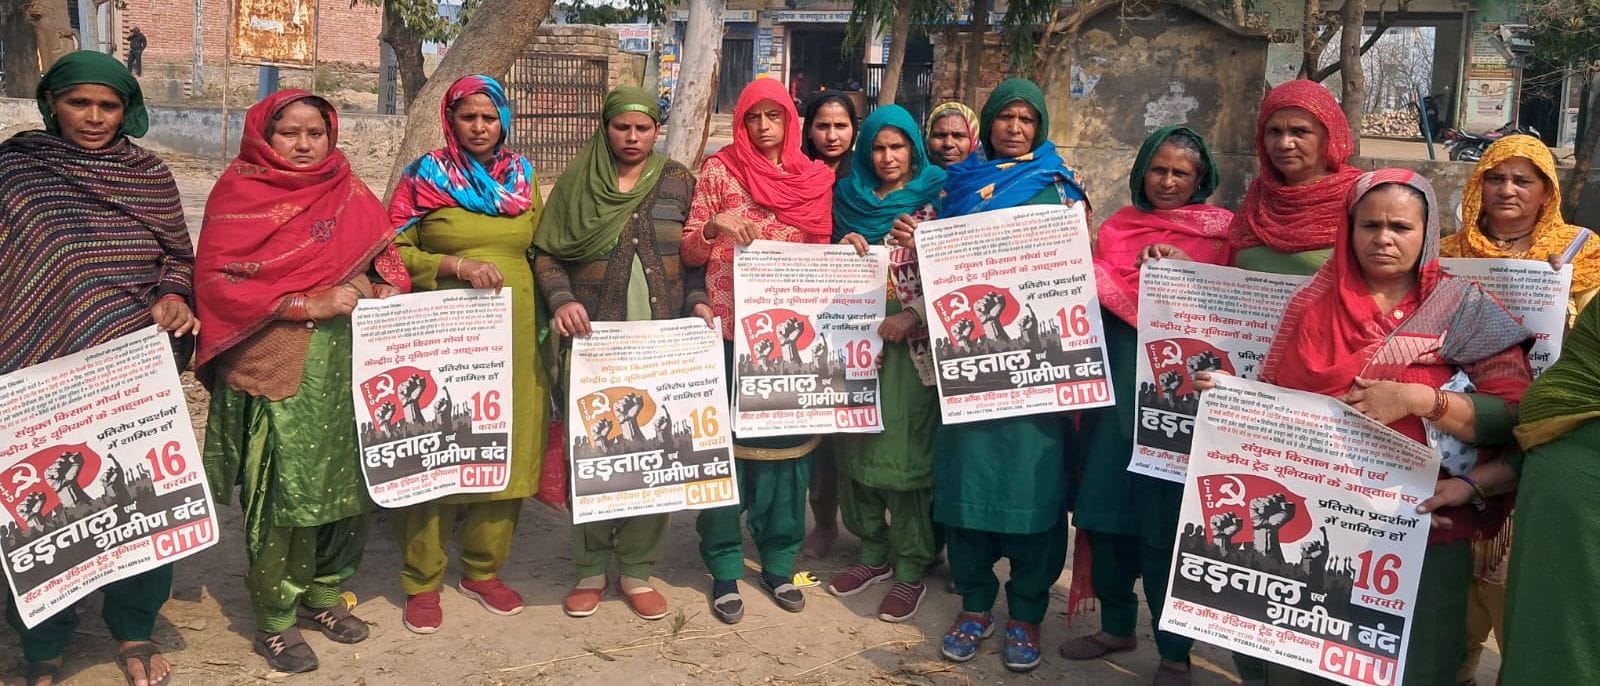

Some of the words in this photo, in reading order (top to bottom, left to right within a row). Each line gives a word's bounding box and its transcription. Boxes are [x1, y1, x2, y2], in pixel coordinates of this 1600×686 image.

[933, 272, 963, 285] केन्द्रीय
[966, 272, 977, 282] ट्रेड
[981, 265, 1017, 281] यूनियनों
[1070, 258, 1082, 266] पर
[954, 261, 983, 272] संयुक्त
[986, 255, 1016, 266] किसान
[1020, 252, 1041, 260] मोर्चा
[1043, 248, 1058, 258] एवं
[1018, 278, 1050, 291] प्रतिरोध
[1053, 274, 1087, 286] प्रदर्शनों
[1026, 290, 1035, 300] में
[1038, 288, 1068, 300] शामिल
[1071, 286, 1082, 296] हों
[936, 300, 950, 322] CITU
[1057, 304, 1090, 338] 16
[1174, 311, 1206, 322] संयुक्त
[1209, 314, 1242, 326] किसान
[1245, 320, 1268, 330] मोर्चा
[386, 342, 411, 353] संयुक्त
[413, 338, 440, 347] किसान
[443, 335, 464, 343] मोर्चा
[466, 333, 480, 341] एवं
[1150, 321, 1181, 330] केन्द्रीय
[1184, 326, 1197, 335] ट्रेड
[1201, 327, 1241, 338] यूनियनों
[438, 363, 469, 372] प्रतिरोध
[845, 340, 872, 368] 16
[940, 349, 1031, 382] हड़ताल
[1035, 351, 1046, 361] एवं
[1150, 344, 1160, 369] CITU
[1244, 364, 1254, 372] में
[740, 375, 818, 399] हड़ताल
[1009, 361, 1070, 388] ग्रामीण
[1074, 357, 1102, 377] बंद
[365, 382, 375, 405] CITU
[471, 390, 501, 421] 16
[797, 387, 849, 408] ग्रामीण
[853, 387, 875, 403] बंद
[1058, 380, 1108, 404] CITU
[0, 443, 28, 458] न्द्रीय
[32, 435, 47, 448] ट्रेड
[51, 416, 93, 442] यूनियनों
[96, 410, 108, 420] के
[156, 389, 172, 398] पर
[15, 418, 52, 438] संयुक्त
[54, 403, 93, 422] किसान
[95, 390, 121, 407] मोर्चा
[123, 383, 140, 396] एवं
[96, 420, 135, 440] प्रतिरोध
[138, 405, 178, 426] प्रदर्शनों
[690, 406, 719, 438] 16
[836, 408, 877, 427] CITU
[1141, 407, 1197, 438] हड़त
[107, 440, 118, 450] में
[120, 427, 158, 446] शामिल
[160, 420, 173, 433] हों
[364, 432, 442, 468] हड़ताल
[146, 440, 186, 482] 16
[421, 443, 476, 471] ग्रामीण
[481, 441, 506, 460] बंद
[576, 450, 664, 481] हड़ताल
[1241, 442, 1282, 458] संयुक्त
[1285, 450, 1330, 468] किसान
[1333, 461, 1363, 478] मोर्चा
[1367, 469, 1388, 481] एवं
[162, 471, 198, 491] फरवरी
[462, 466, 504, 485] CITU
[642, 462, 700, 488] ग्रामीण
[703, 457, 729, 476] बंद
[1207, 450, 1249, 466] केन्द्रीय
[1252, 458, 1269, 472] ट्रेड
[1274, 465, 1326, 483] यूनियनों
[1327, 477, 1342, 488] के
[1400, 494, 1418, 504] पर
[688, 480, 731, 503] CITU
[1203, 479, 1214, 508] CITU
[94, 511, 167, 551] ग्रामीण
[172, 497, 205, 521] बंद
[1318, 499, 1365, 516] प्रतिरोध
[1368, 511, 1420, 529] प्रदर्शनों
[1325, 516, 1338, 525] में
[1340, 519, 1386, 537] शामिल
[1388, 530, 1407, 542] हों
[8, 504, 118, 574] हड़ताल
[123, 501, 137, 513] एवं
[156, 521, 212, 556] CITU
[65, 562, 96, 584] इंडियन
[97, 553, 109, 568] ट्रेड
[1180, 552, 1306, 605] हड़ताल
[1311, 592, 1327, 603] एवं
[1354, 550, 1402, 596] 16
[1360, 594, 1406, 611] फरवरी
[1195, 608, 1219, 622] ऑफ
[1222, 614, 1256, 631] इंडियन
[1258, 623, 1272, 636] ट्रेड
[1276, 630, 1320, 650] यूनियन्स
[1266, 600, 1353, 641] ग्रामीण
[1357, 623, 1400, 654] बंद
[1324, 646, 1395, 686] CITU
